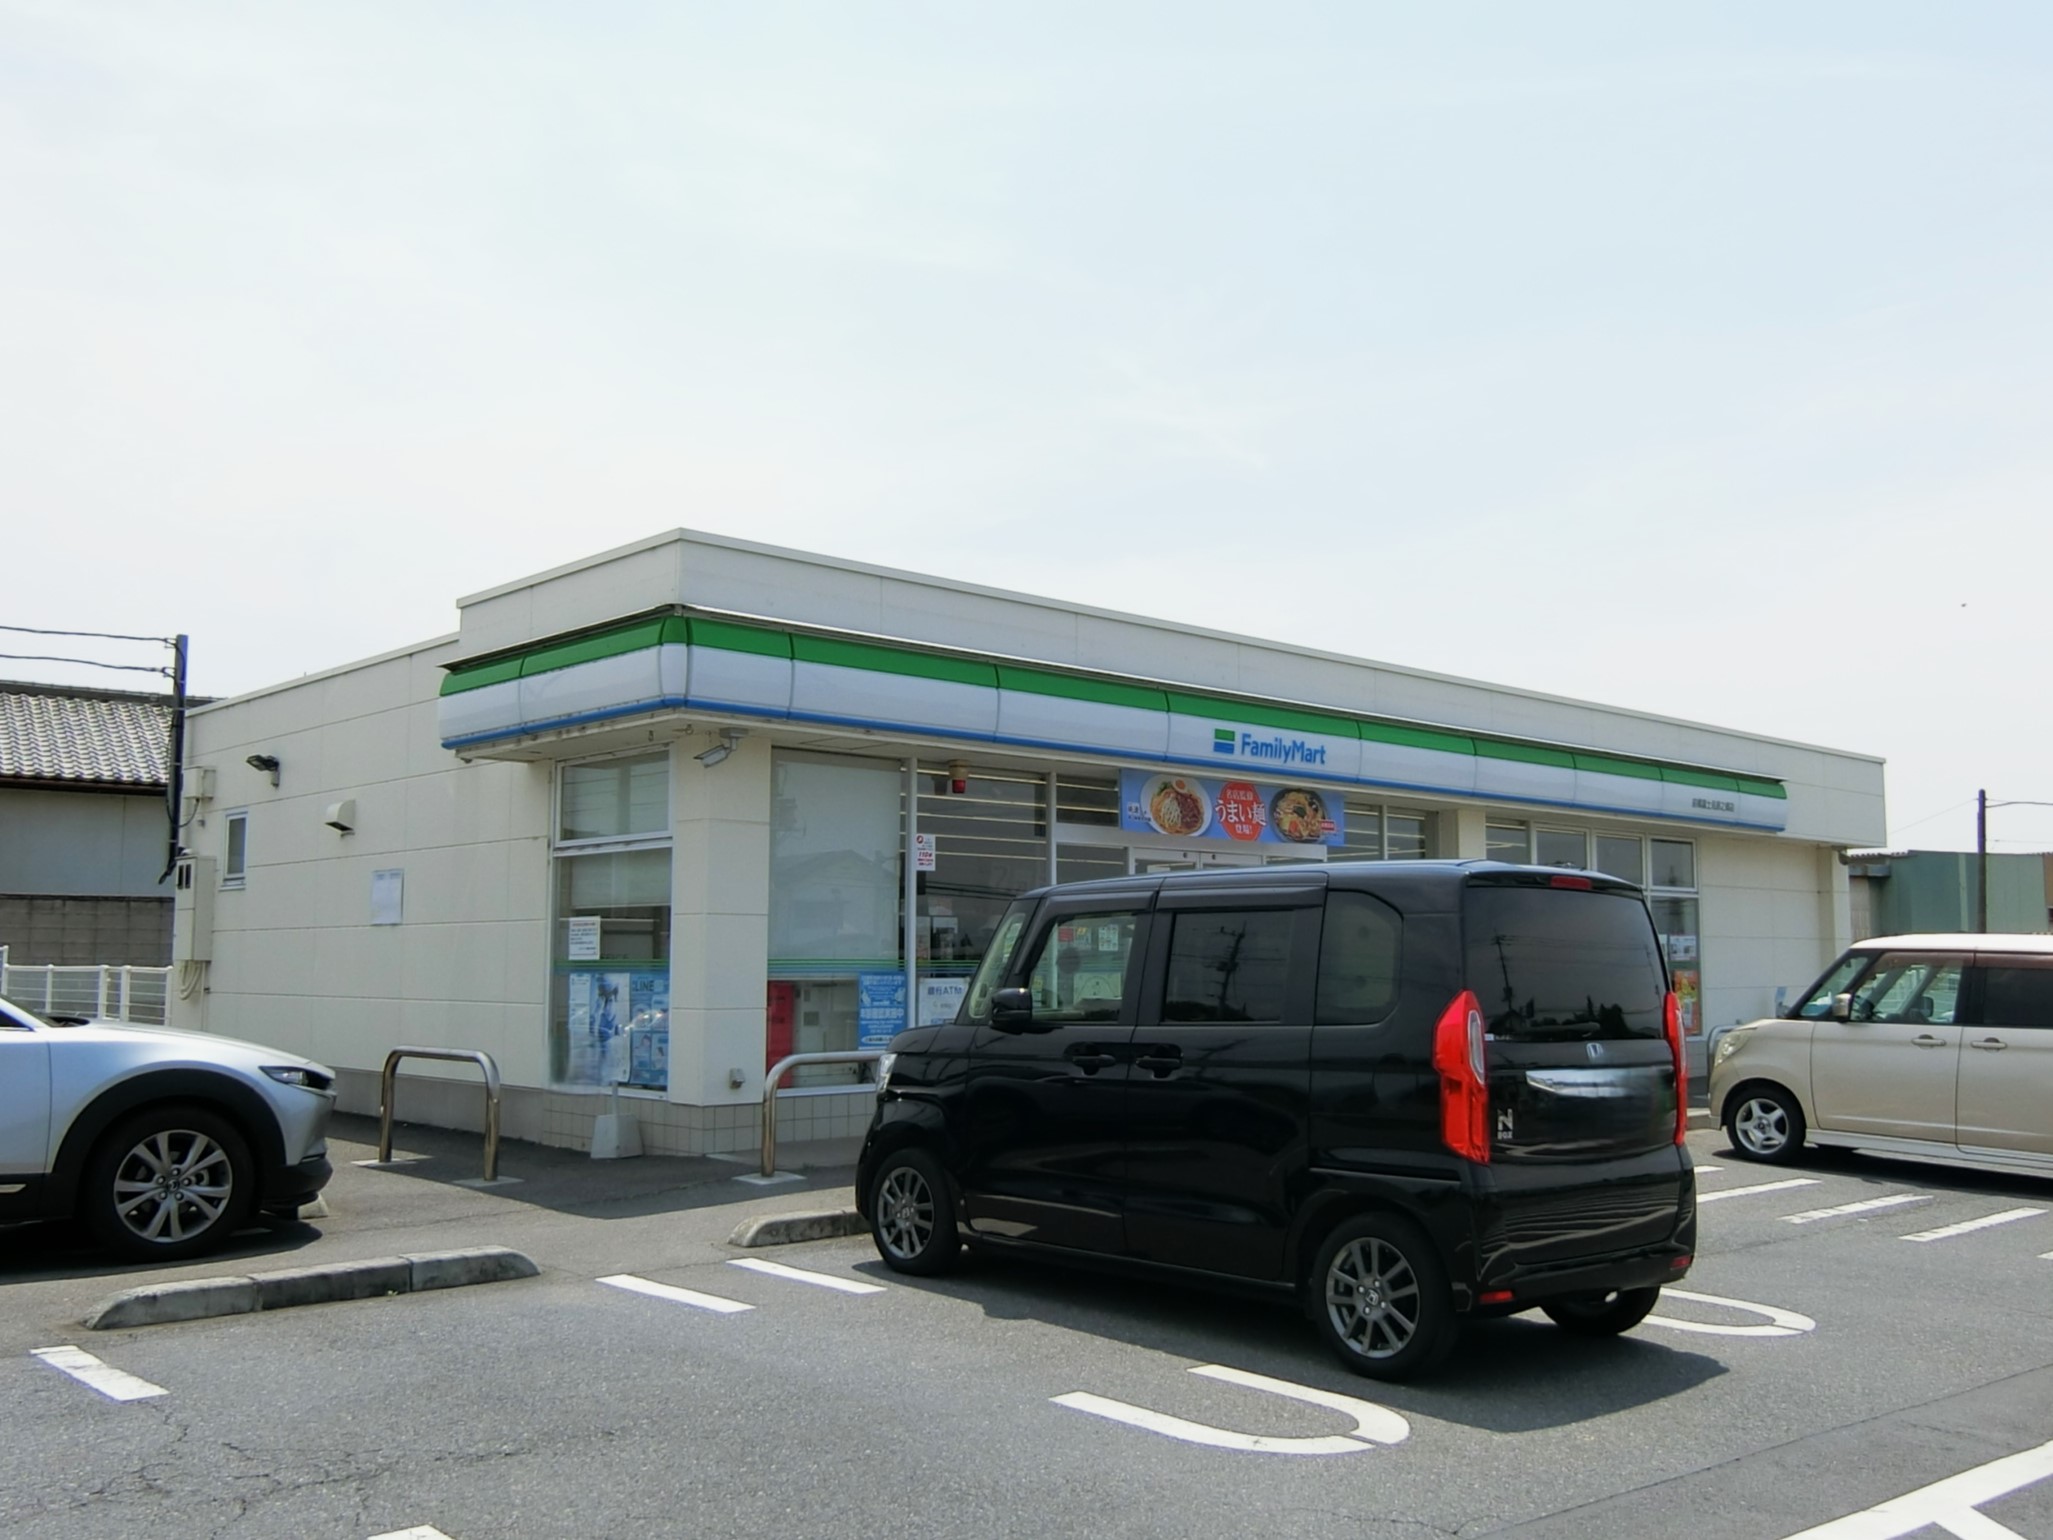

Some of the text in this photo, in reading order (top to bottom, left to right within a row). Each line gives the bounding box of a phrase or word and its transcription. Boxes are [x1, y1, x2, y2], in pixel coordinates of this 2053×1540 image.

[1241, 733, 1326, 765] FamilyMart
[1215, 799, 1267, 826] うまい麺
[1497, 1108, 1513, 1131] N
